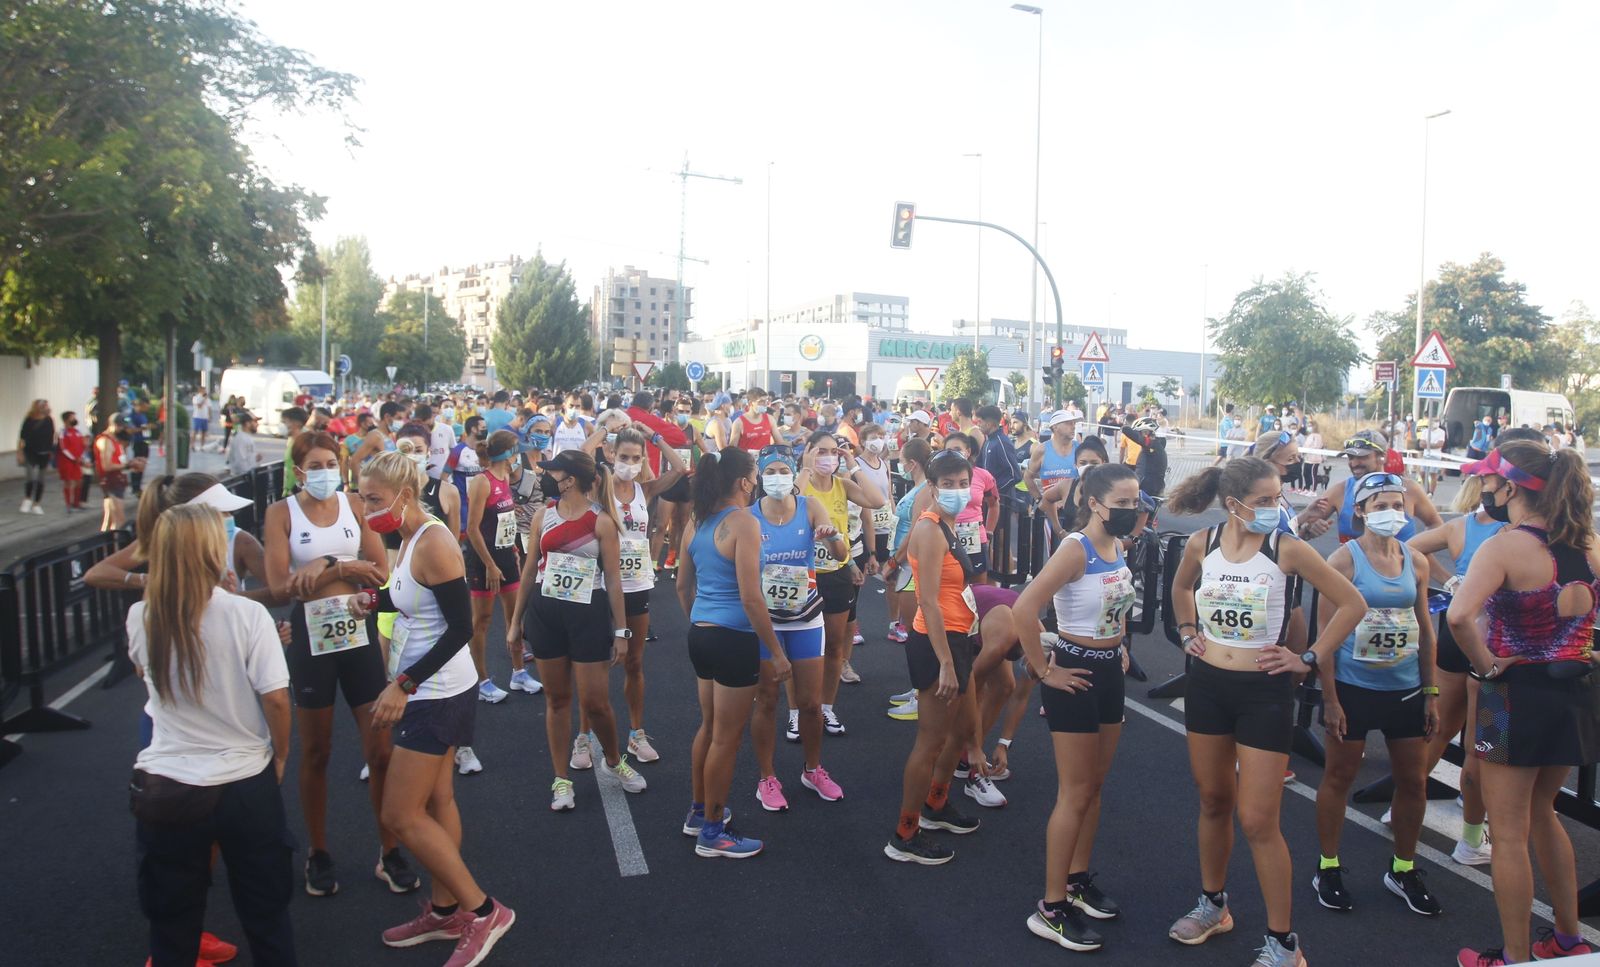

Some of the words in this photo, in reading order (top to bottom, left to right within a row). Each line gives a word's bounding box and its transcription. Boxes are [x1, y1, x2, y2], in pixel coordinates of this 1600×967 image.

[874, 513, 889, 523] 152
[764, 549, 807, 562] nerplus
[620, 558, 642, 570] 295
[552, 574, 584, 590] 307
[767, 585, 799, 600] 452
[1210, 609, 1253, 628] 486
[322, 619, 357, 639] 289
[1368, 632, 1408, 649] 453
[1082, 649, 1115, 660] PRO
